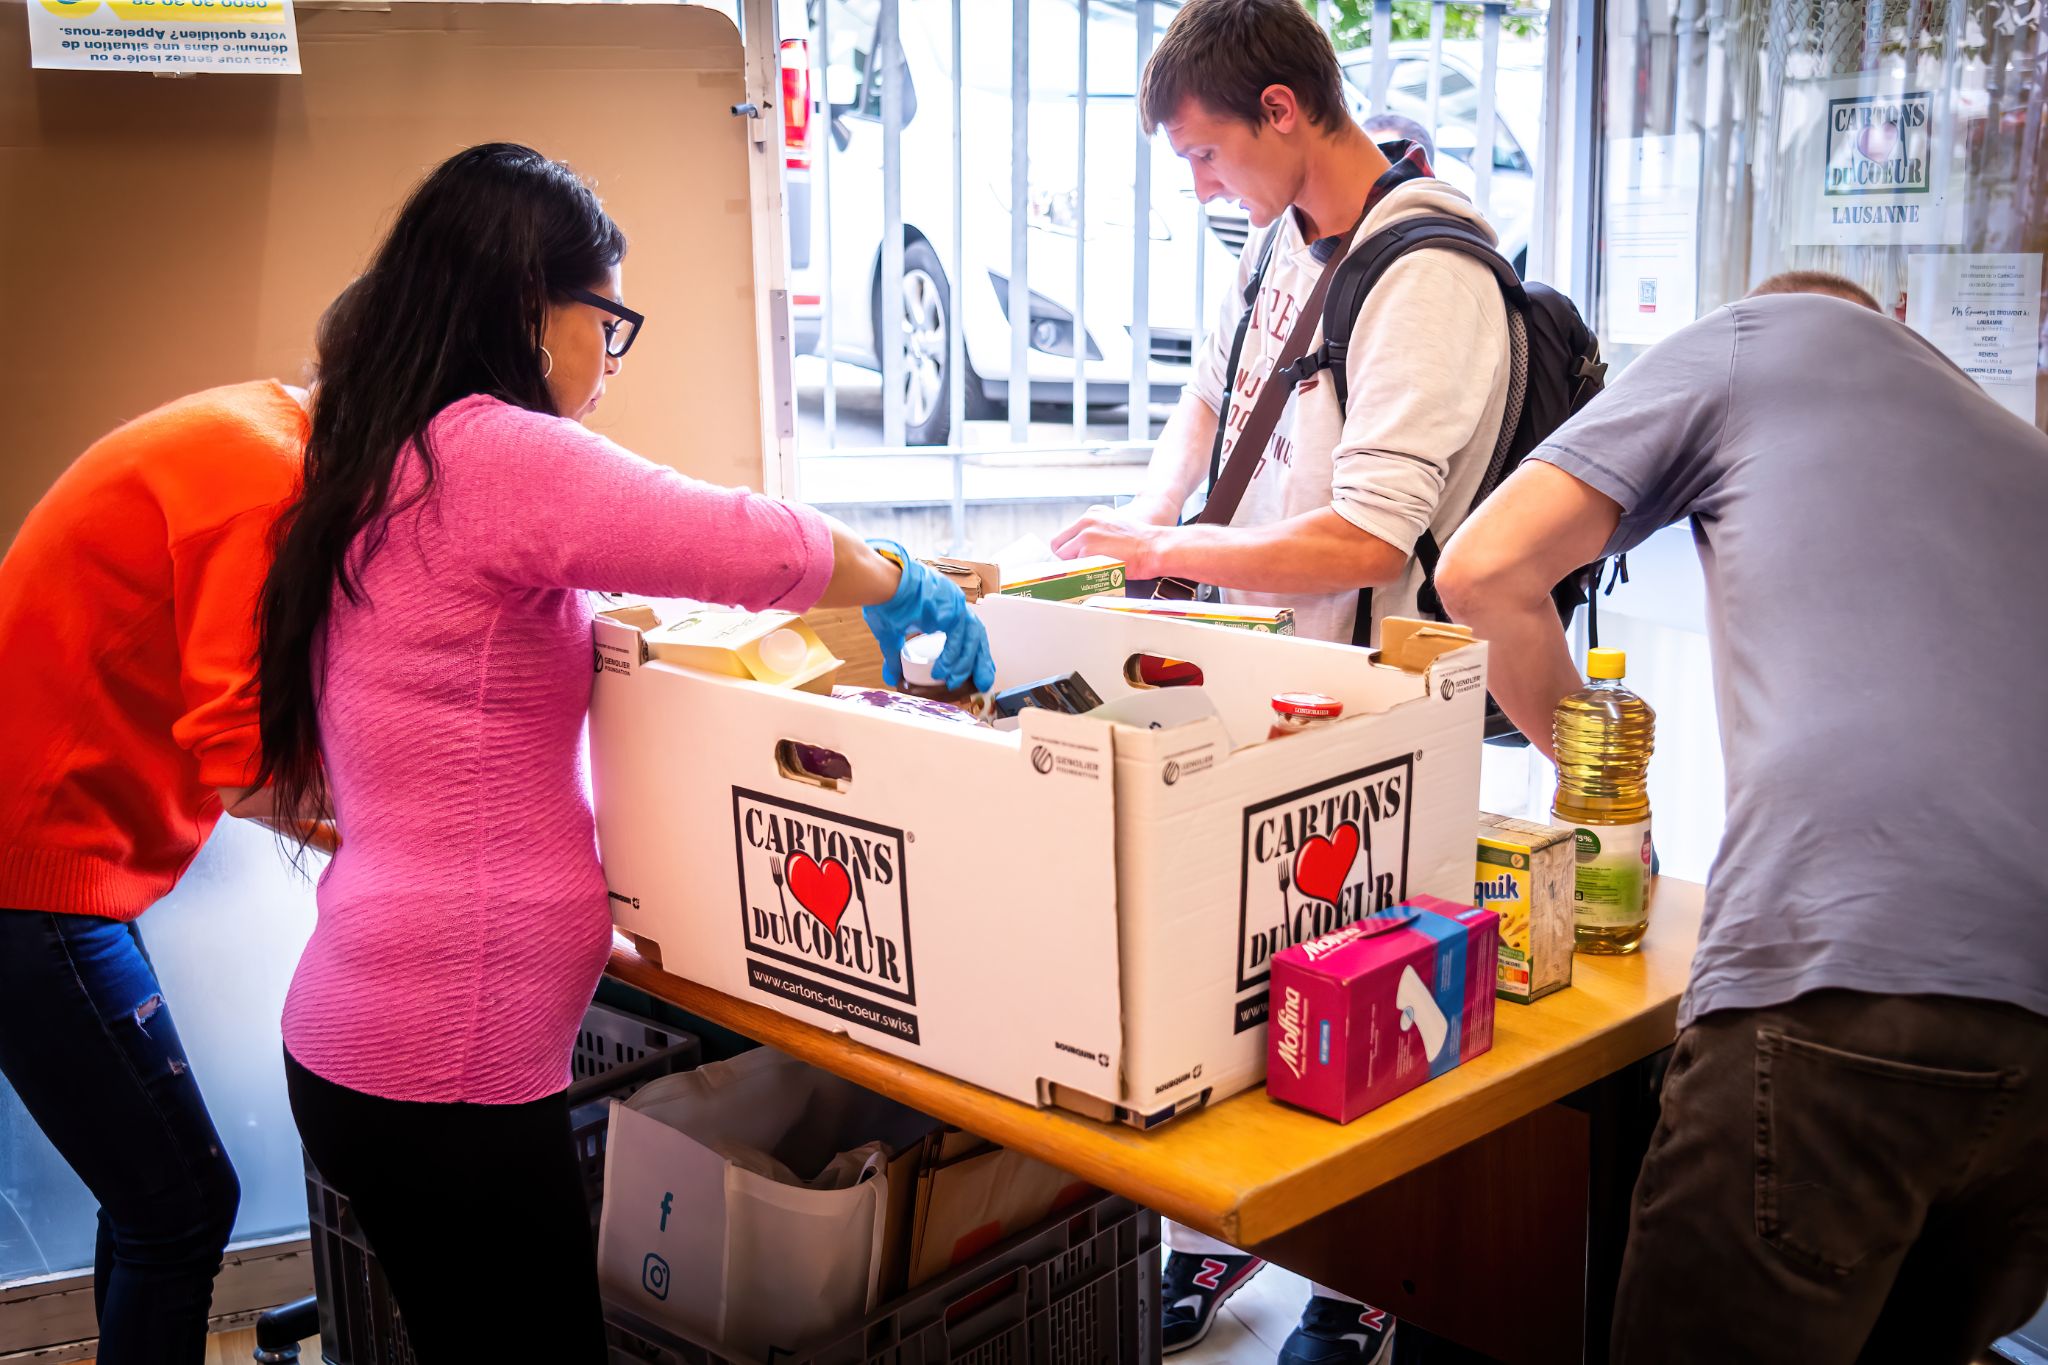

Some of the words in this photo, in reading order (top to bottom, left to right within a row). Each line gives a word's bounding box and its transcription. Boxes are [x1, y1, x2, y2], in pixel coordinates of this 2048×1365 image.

[59, 26, 166, 39] Appelez-nous.
[170, 29, 246, 41] quotidien?
[250, 31, 287, 41] votre
[61, 40, 80, 49] de
[84, 40, 149, 51] situation
[153, 43, 180, 51] une
[184, 43, 220, 52] dans
[89, 53, 109, 61] ou
[165, 53, 213, 64] sentez
[1834, 103, 1925, 132] CARTONS
[1832, 167, 1852, 186] DU
[1857, 158, 1922, 185] COEUR
[1832, 205, 1920, 224] LAUSANNE
[604, 656, 631, 669] GENOLIER
[1254, 774, 1401, 864] CARTONS
[745, 807, 893, 885] CARTONS
[1474, 873, 1520, 909] quik
[1249, 924, 1287, 969] DU
[1293, 871, 1395, 944] COEUR
[752, 906, 785, 946] DU
[793, 909, 902, 984] COEUR
[1302, 927, 1362, 962] Molfina
[753, 968, 914, 1036] www.cartons-du-coeur.swiss
[1277, 986, 1300, 1080] Molfina
[1055, 1040, 1096, 1061] BOURQUIN
[1155, 1071, 1191, 1094] BOURQUIN
[1193, 1258, 1228, 1291] N
